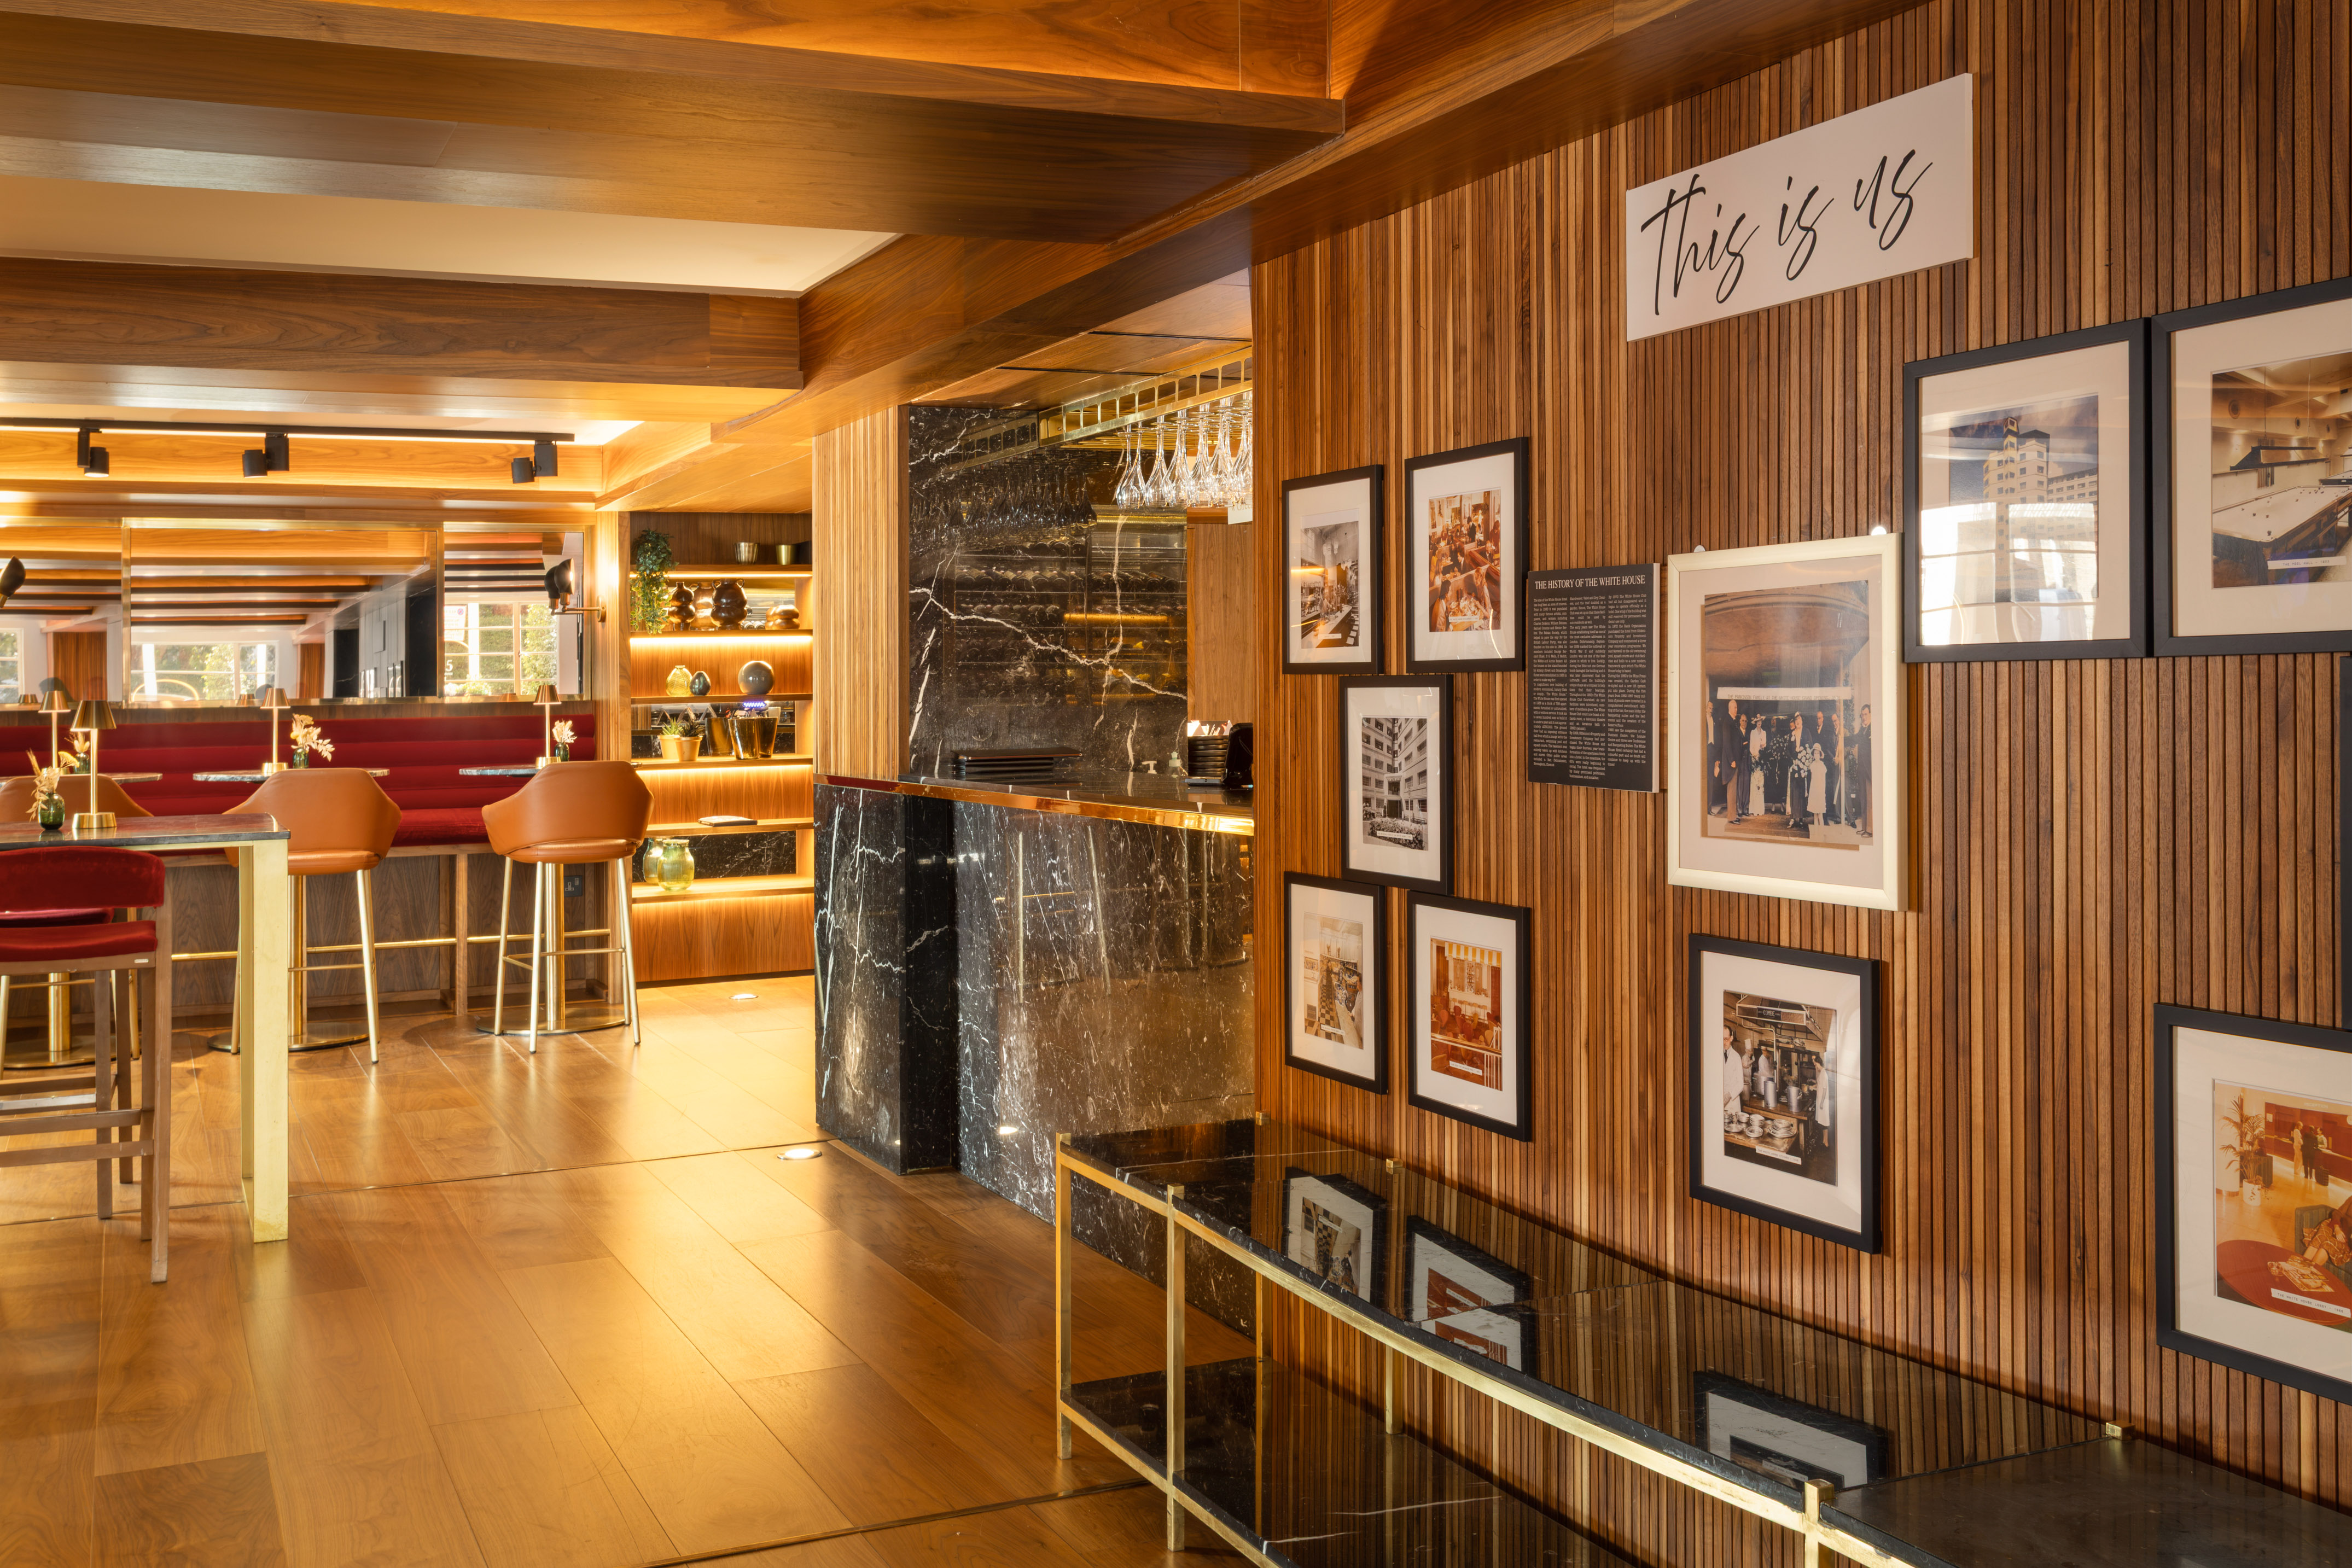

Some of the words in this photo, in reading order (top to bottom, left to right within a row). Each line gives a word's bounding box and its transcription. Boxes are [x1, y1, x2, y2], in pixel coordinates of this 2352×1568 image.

[1641, 173, 1760, 316] This
[1778, 176, 1835, 281] is
[1854, 149, 1933, 251] us
[1535, 581, 1547, 589] THE
[1548, 579, 1574, 588] HISTORY
[1575, 579, 1584, 587] OF
[1585, 578, 1598, 587] THE
[1599, 576, 1621, 586] WHITE
[1622, 575, 1645, 585] HOUSE
